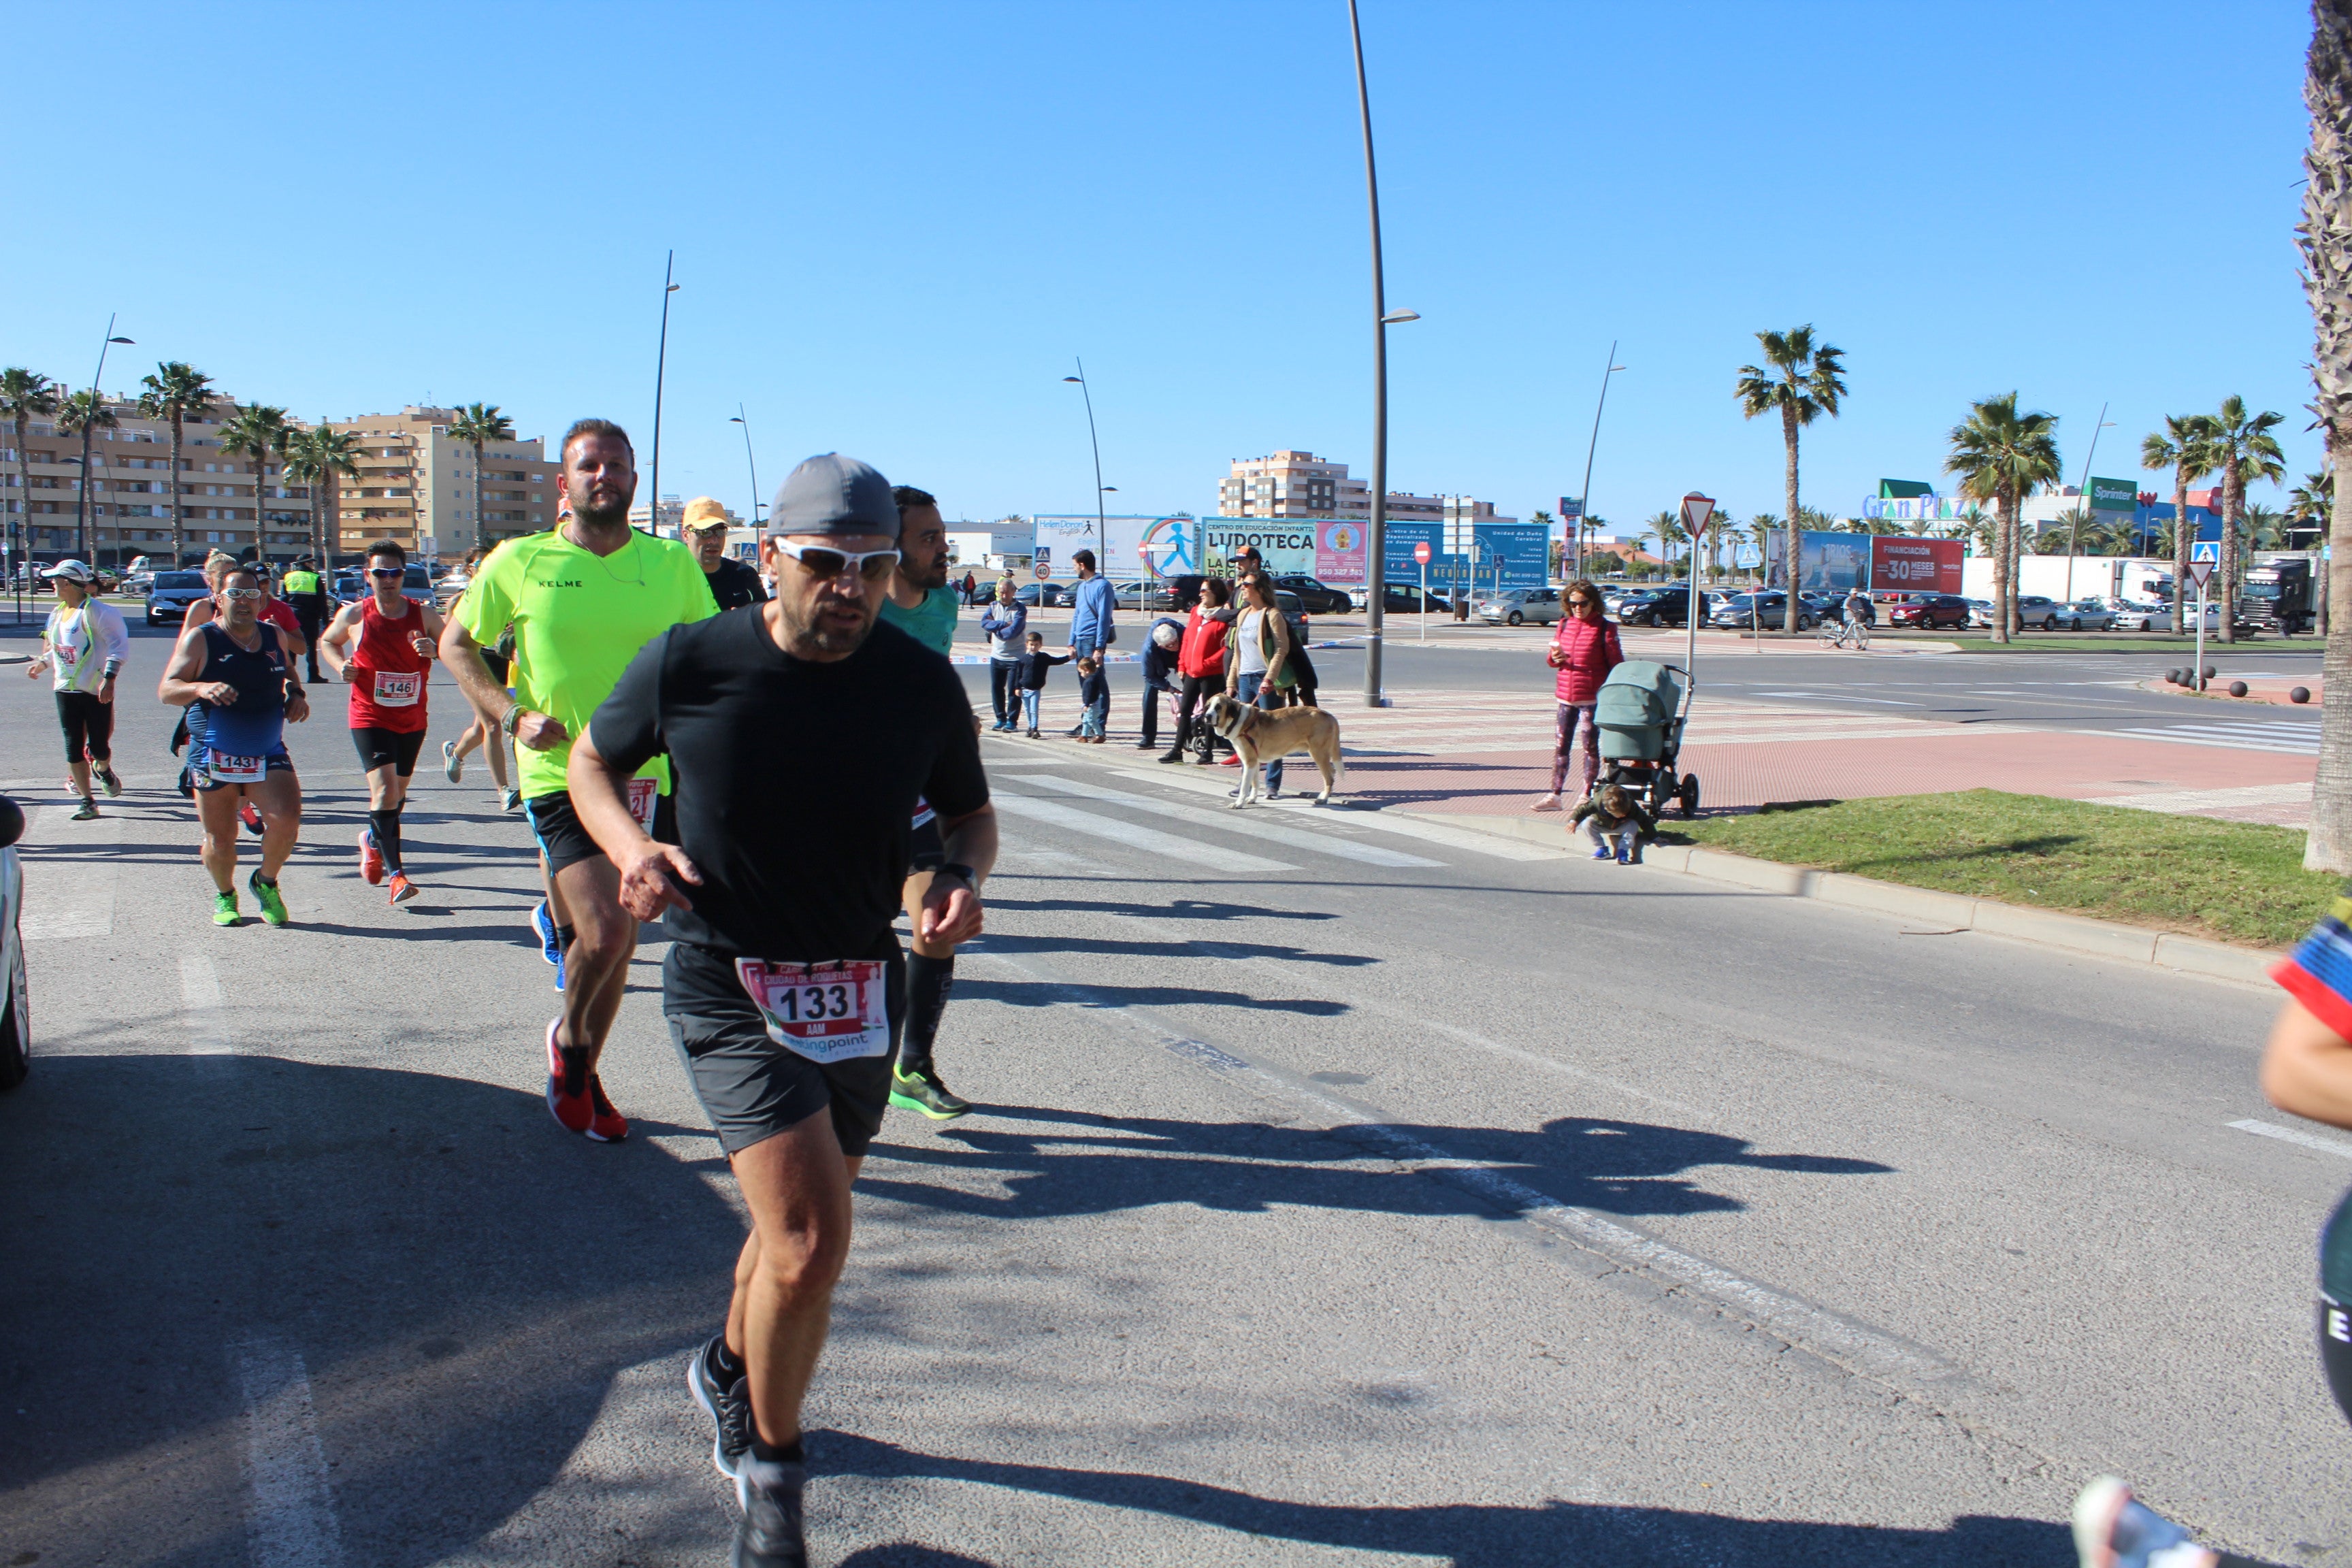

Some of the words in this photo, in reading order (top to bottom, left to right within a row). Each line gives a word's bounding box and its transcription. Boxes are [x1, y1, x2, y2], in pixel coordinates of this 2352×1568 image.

[2095, 485, 2132, 501] Sprinter
[1039, 520, 1060, 528] Helen
[1208, 533, 1314, 549] LUDOTECA
[1884, 545, 1931, 555] FINANCIACIÓN
[1208, 558, 1223, 568] LA
[1911, 561, 1935, 570] MESES
[1209, 570, 1224, 578] DE
[1888, 560, 1910, 579] 30
[389, 683, 411, 693] 146
[225, 755, 251, 768] 143
[764, 975, 796, 985] CIUDAD
[798, 974, 809, 984] DE
[811, 970, 853, 983] ROQUETAS
[781, 985, 849, 1021] 133
[806, 1023, 826, 1035] AAM
